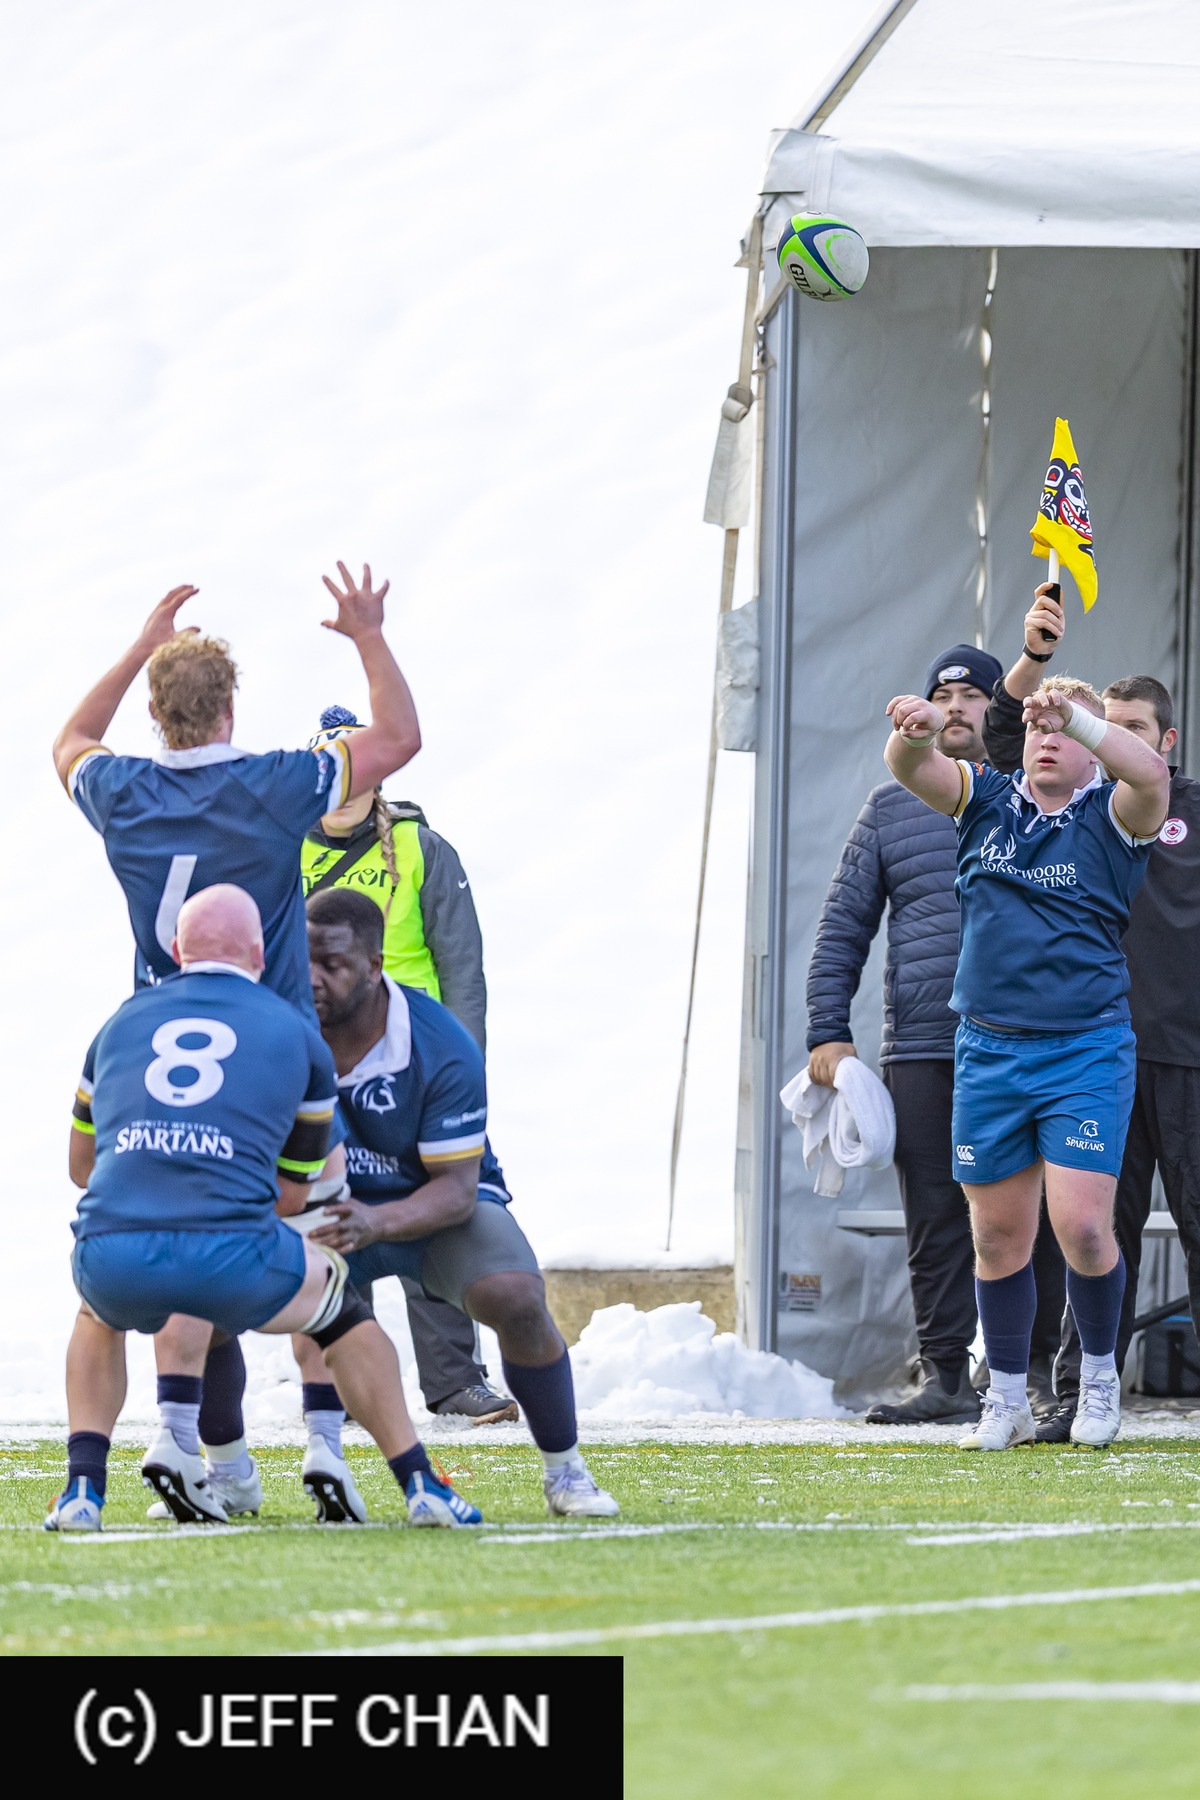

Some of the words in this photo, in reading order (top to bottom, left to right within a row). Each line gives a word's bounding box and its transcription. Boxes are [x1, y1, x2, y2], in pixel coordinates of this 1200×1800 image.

[789, 263, 818, 298] GILB
[144, 1017, 237, 1107] 8
[114, 1126, 234, 1160] SPARTANS
[1065, 1136, 1105, 1152] SPARTANS
